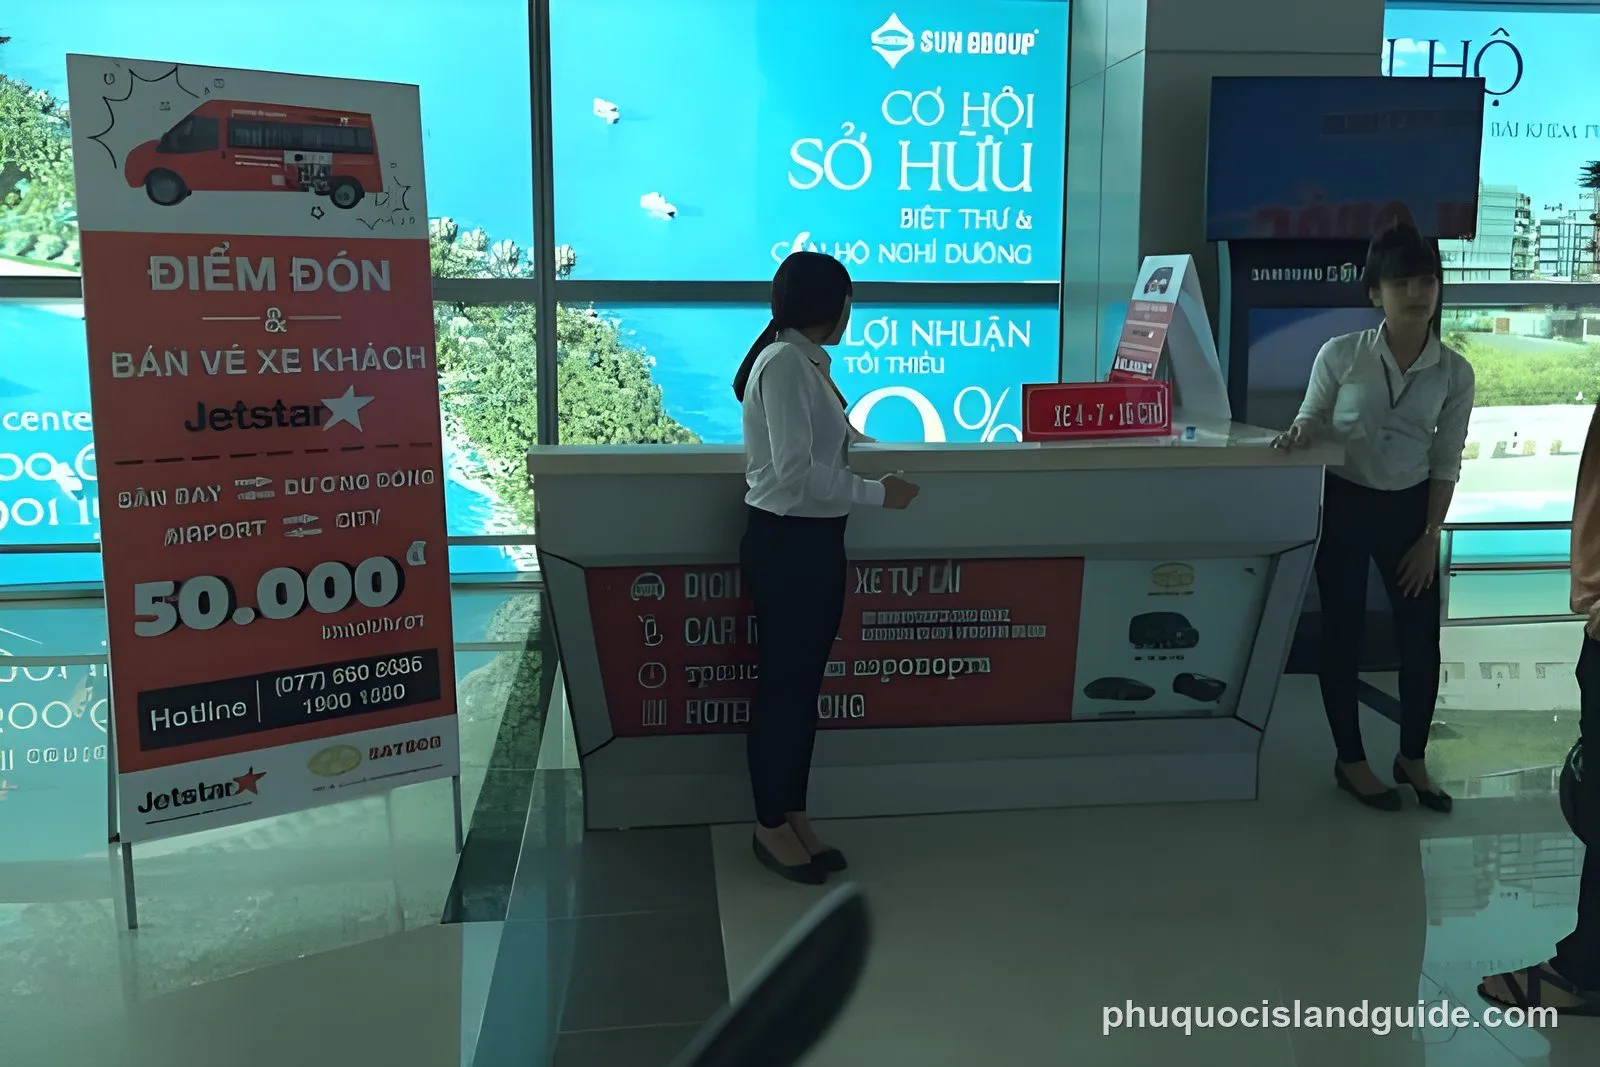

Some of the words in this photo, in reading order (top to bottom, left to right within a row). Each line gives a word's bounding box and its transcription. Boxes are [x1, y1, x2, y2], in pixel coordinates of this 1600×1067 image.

[920, 30, 963, 54] SUN
[1015, 209, 1033, 230] &
[147, 241, 277, 292] ĐIỂM
[289, 250, 391, 293] ĐÓN
[265, 307, 287, 333] &
[845, 316, 898, 350] LỢI
[111, 345, 189, 379] BÁN
[257, 348, 302, 375] XE
[184, 400, 323, 432] Jetstar
[134, 556, 402, 638] 50.000
[684, 615, 737, 646] CAR
